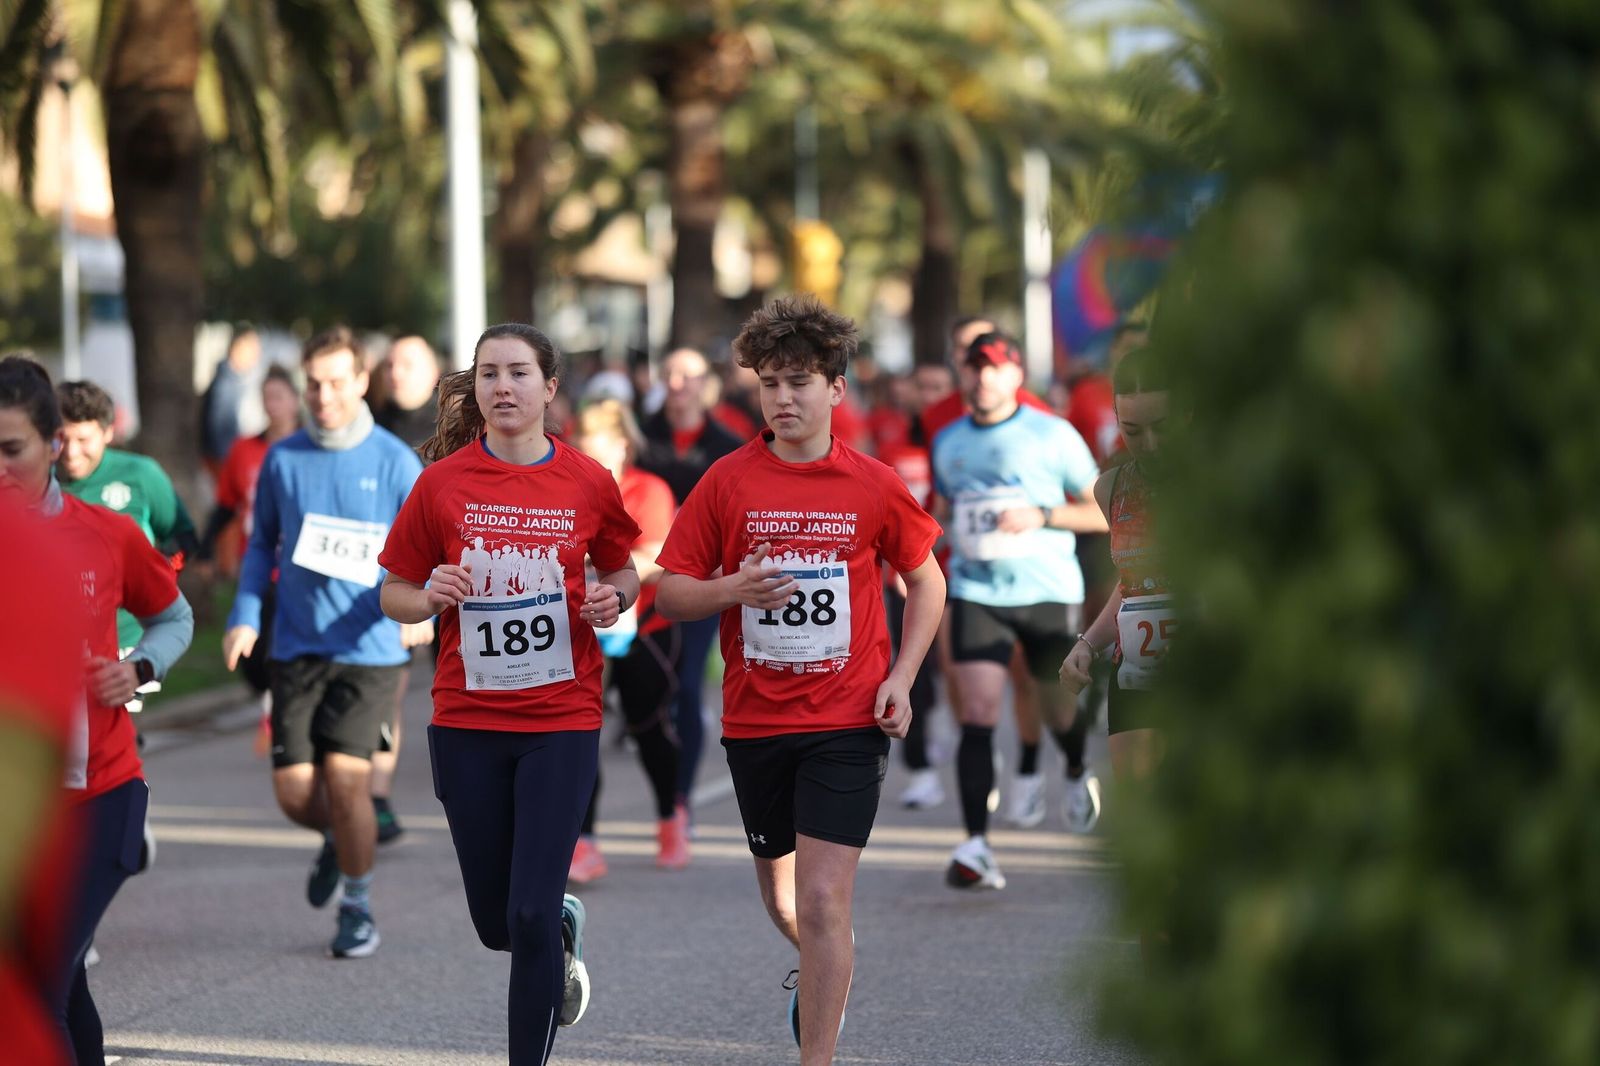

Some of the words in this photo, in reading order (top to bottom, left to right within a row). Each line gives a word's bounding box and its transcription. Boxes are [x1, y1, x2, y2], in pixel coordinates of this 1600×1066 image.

[465, 503, 478, 511] VIII
[480, 504, 523, 514] CARRERA
[525, 508, 563, 517] URBANA
[564, 509, 576, 517] DE
[746, 511, 759, 519] VIII
[761, 511, 804, 519] CARRERA
[806, 511, 843, 520] URBANA
[845, 513, 857, 521] DE
[464, 513, 519, 527] CIUDAD
[522, 517, 574, 531] JARDÍN
[746, 521, 800, 533] CIUDAD
[803, 521, 855, 535] JARDÍN
[311, 532, 370, 562] 363
[477, 614, 556, 656] 189
